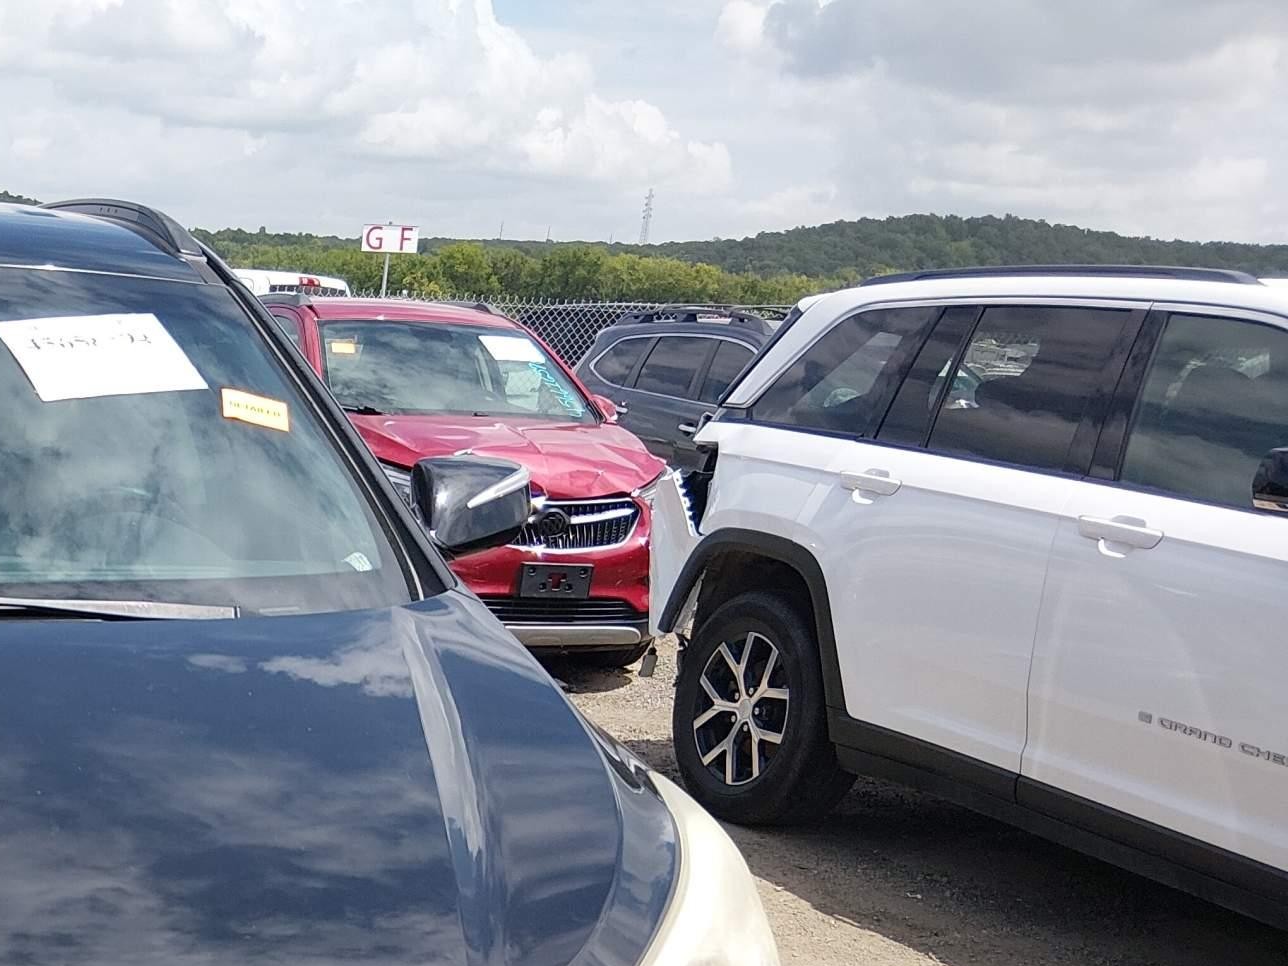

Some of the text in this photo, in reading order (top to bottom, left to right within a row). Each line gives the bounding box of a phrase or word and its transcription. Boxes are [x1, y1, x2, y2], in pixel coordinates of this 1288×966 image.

[365, 226, 414, 251] G F
[1158, 717, 1288, 768] GRAND CHE
